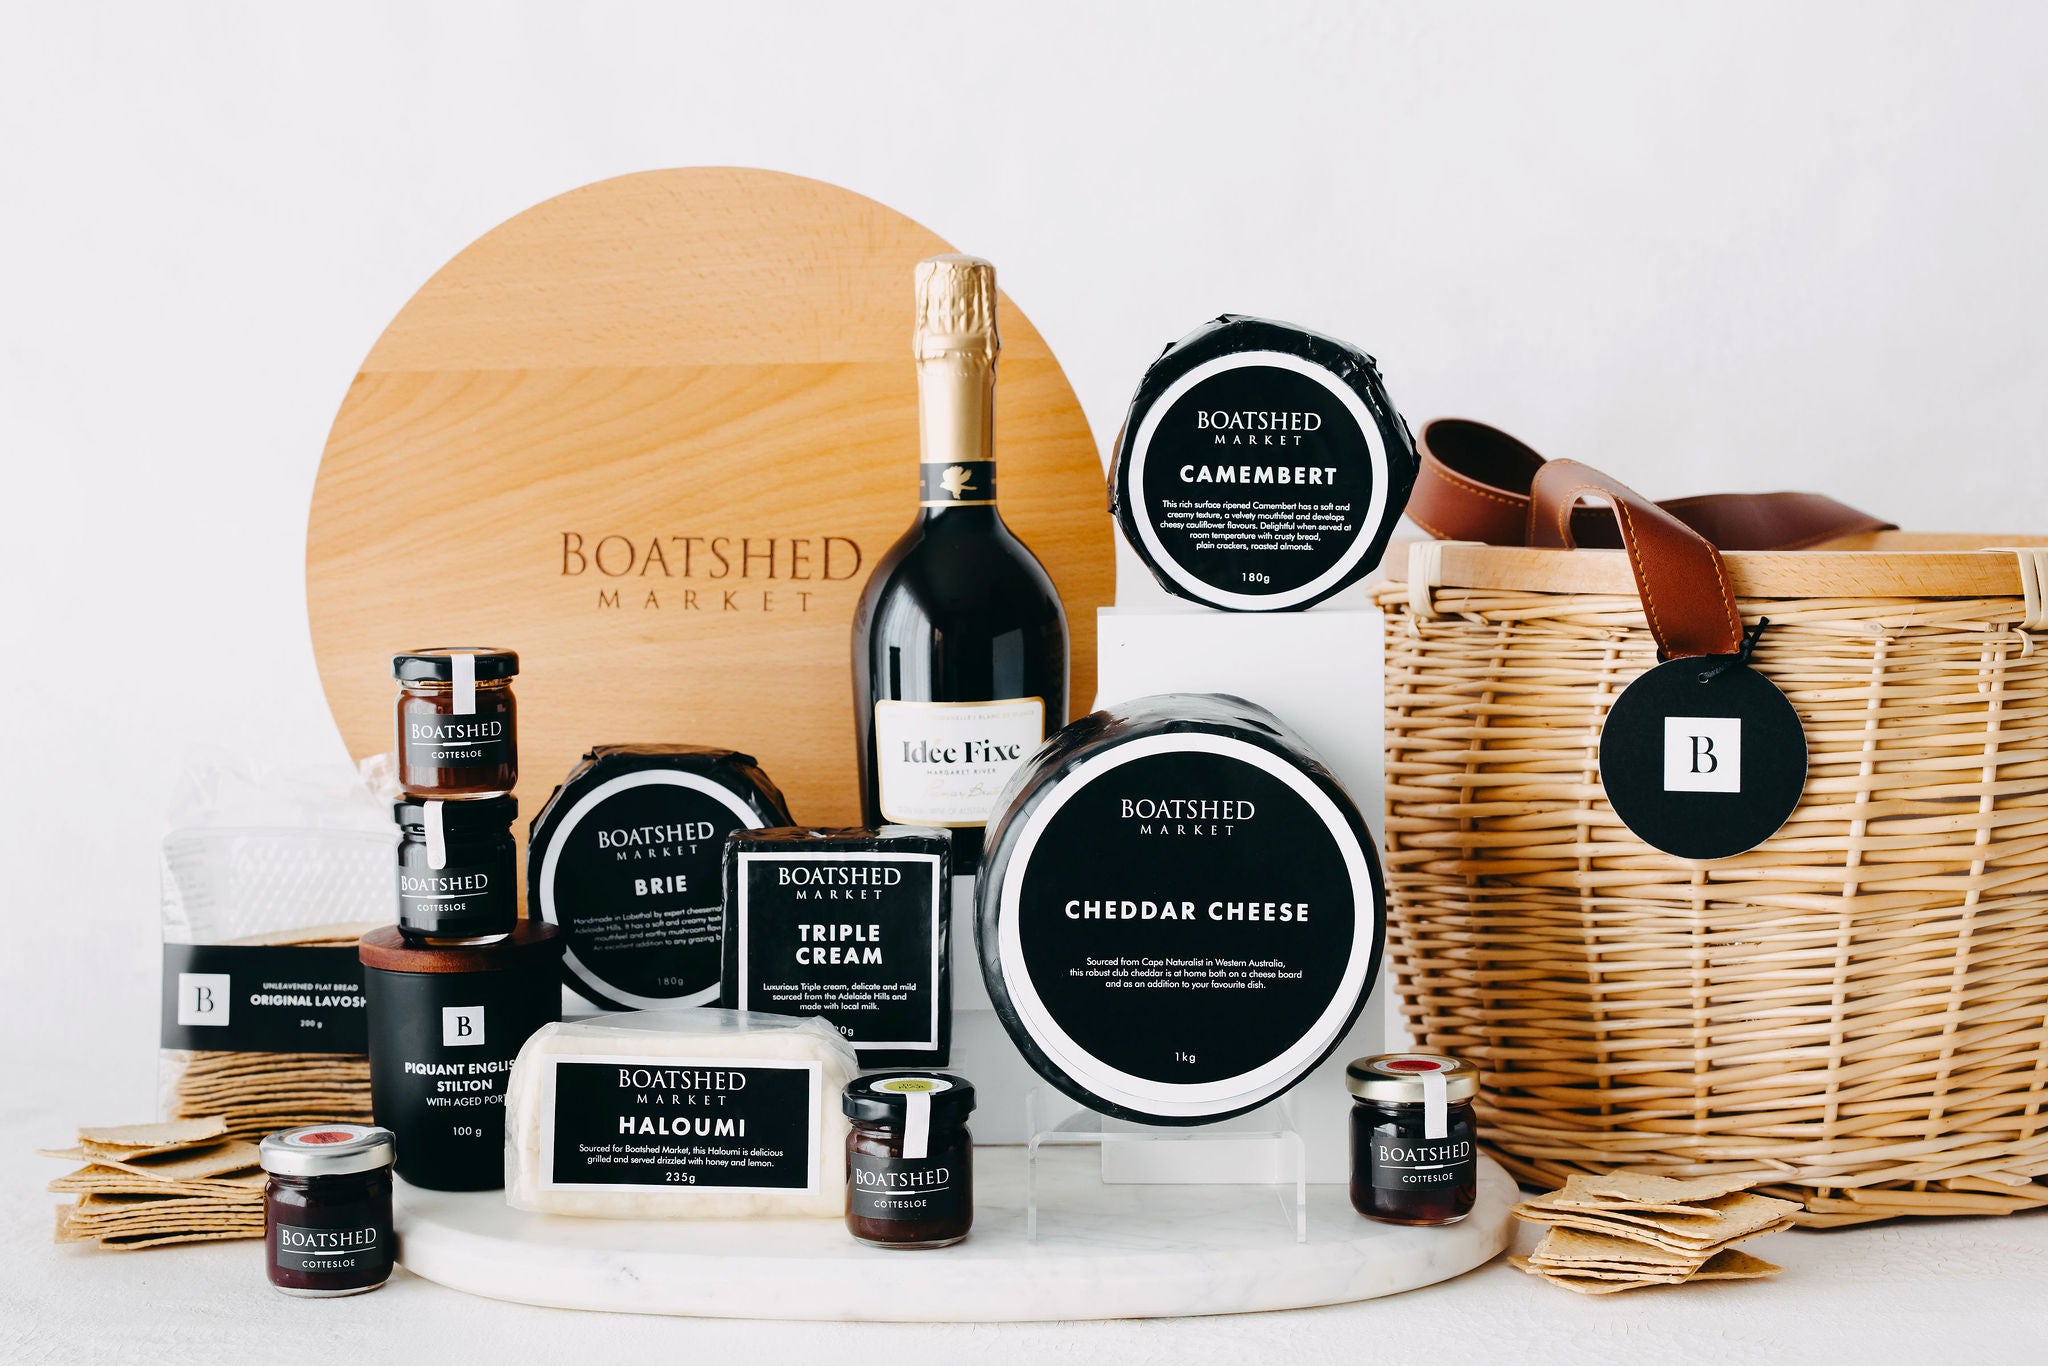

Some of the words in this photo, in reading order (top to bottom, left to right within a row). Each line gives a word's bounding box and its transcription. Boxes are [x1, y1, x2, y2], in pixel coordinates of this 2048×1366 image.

[1198, 411, 1321, 430] BOATSHED
[1215, 435, 1301, 445] MARKET
[1180, 465, 1336, 484] CAMEMBERT
[1162, 500, 1177, 508] This
[1179, 500, 1192, 508] rich
[1194, 501, 1221, 509] surface
[1223, 501, 1250, 511] ripened
[1253, 501, 1296, 510] Camembert
[1298, 502, 1312, 510] has
[1320, 503, 1333, 511] soft
[1335, 503, 1350, 511] and
[1168, 512, 1194, 520] creamy
[1196, 511, 1222, 520] texture,
[1232, 511, 1256, 521] velvety
[1258, 512, 1294, 520] mouthfeel
[1296, 512, 1310, 520] and
[1312, 513, 1344, 523] develops
[1160, 520, 1184, 530] cheesy
[1186, 520, 1225, 529] cauliflower
[1227, 521, 1258, 529] flavours.
[1260, 521, 1295, 532] Delightful
[1297, 522, 1316, 530] when
[1318, 522, 1342, 530] served
[1344, 523, 1351, 531] at
[1212, 531, 1256, 541] temperature
[1258, 531, 1272, 539] with
[1274, 531, 1295, 541] crusty
[1297, 532, 1320, 541] bread,
[1196, 541, 1214, 551] plain
[1217, 541, 1248, 551] crackers,
[1251, 542, 1278, 550] roasted
[1280, 542, 1313, 550] almonds.
[562, 533, 862, 580] BOATSHED
[1243, 573, 1269, 584] 180g
[600, 588, 813, 614] MARKET
[412, 721, 502, 739] BOATSHED
[431, 750, 482, 759] COTTESLOE
[964, 739, 1021, 763] Fixe
[1688, 736, 1717, 773] B
[1122, 799, 1254, 819] BOATSHED
[598, 822, 714, 848] BOATSHED
[1141, 825, 1233, 835] MARKET
[617, 845, 696, 860] MARKET
[779, 867, 900, 885] BOATSHED
[401, 874, 488, 891] BOATSHED
[635, 875, 686, 896] BRIE
[797, 890, 882, 899] MARKET
[417, 903, 466, 912] COTTESLOE
[1066, 900, 1195, 920] CHEDDAR
[1208, 902, 1308, 921] CHEESE
[798, 924, 879, 941] TRIPLE
[796, 947, 882, 964] CREAM
[1087, 957, 1118, 966] Sourced
[1121, 958, 1139, 966] from
[1142, 958, 1163, 968] Cape
[1166, 958, 1203, 967] Naturalist
[1206, 959, 1213, 967] in
[1215, 959, 1246, 967] Western
[1248, 959, 1285, 969] Australia,
[1070, 968, 1083, 976] this
[1086, 968, 1110, 977] robust
[1112, 969, 1128, 977] club
[1131, 969, 1163, 977] cheddar
[1166, 969, 1171, 977] is
[1174, 969, 1181, 977] at
[1184, 969, 1206, 978] home
[1209, 969, 1226, 978] both
[1249, 970, 1276, 978] cheese
[1278, 970, 1302, 978] board
[315, 983, 332, 991] FLAT
[334, 984, 358, 992] BREAD
[658, 977, 683, 986] 180g
[764, 982, 798, 990] Luxurious
[801, 982, 821, 992] Triple
[852, 982, 880, 990] delicate
[883, 982, 897, 990] and
[900, 982, 916, 990] mild
[1106, 979, 1121, 988] and
[1147, 980, 1179, 988] addition
[1182, 980, 1189, 988] to
[1192, 982, 1209, 990] your
[1211, 980, 1245, 989] favourite
[1248, 981, 1266, 989] dish.
[195, 986, 214, 1013] B
[250, 994, 312, 1006] ORIGINAL
[773, 992, 802, 1000] sourced
[804, 992, 822, 1000] from
[825, 992, 836, 1000] the
[838, 992, 871, 1000] Adelaide
[874, 992, 890, 1000] Hills
[892, 992, 906, 1000] and
[800, 1002, 822, 1010] made
[824, 1002, 839, 1010] with
[841, 1002, 859, 1010] local
[862, 1002, 879, 1010] milk.
[457, 1016, 472, 1036] B
[405, 1062, 465, 1076] PIQUANT
[469, 1059, 515, 1075] ENGLIS
[437, 1079, 493, 1092] STILTON
[619, 1069, 746, 1090] BOATSHED
[426, 1097, 451, 1107] WITH
[454, 1097, 481, 1107] AGED
[637, 1094, 726, 1105] MARKET
[453, 1127, 472, 1136] 100
[476, 1129, 482, 1137] g
[620, 1116, 744, 1136] HALOUMI
[580, 1144, 611, 1153] Sourced
[612, 1145, 623, 1153] for
[626, 1145, 660, 1154] Boatshed
[661, 1146, 690, 1156] Market,
[693, 1147, 706, 1155] this
[708, 1147, 740, 1156] Haloumi
[743, 1148, 748, 1156] is
[750, 1148, 783, 1157] delicious
[1380, 1141, 1470, 1162] BOATSHED
[588, 1155, 611, 1165] grilled
[614, 1155, 628, 1164] and
[631, 1156, 655, 1164] served
[657, 1156, 686, 1165] drizzled
[688, 1157, 703, 1166] with
[706, 1157, 729, 1168] honey
[731, 1158, 745, 1166] and
[748, 1158, 774, 1167] lemon.
[666, 1172, 695, 1184] 235g
[856, 1168, 949, 1187] BOATSHED
[1402, 1172, 1453, 1183] COTTESLOE
[874, 1200, 927, 1208] COTTESLOE
[282, 1228, 377, 1247] BOATSHED
[302, 1259, 355, 1268] COTTESLOE
